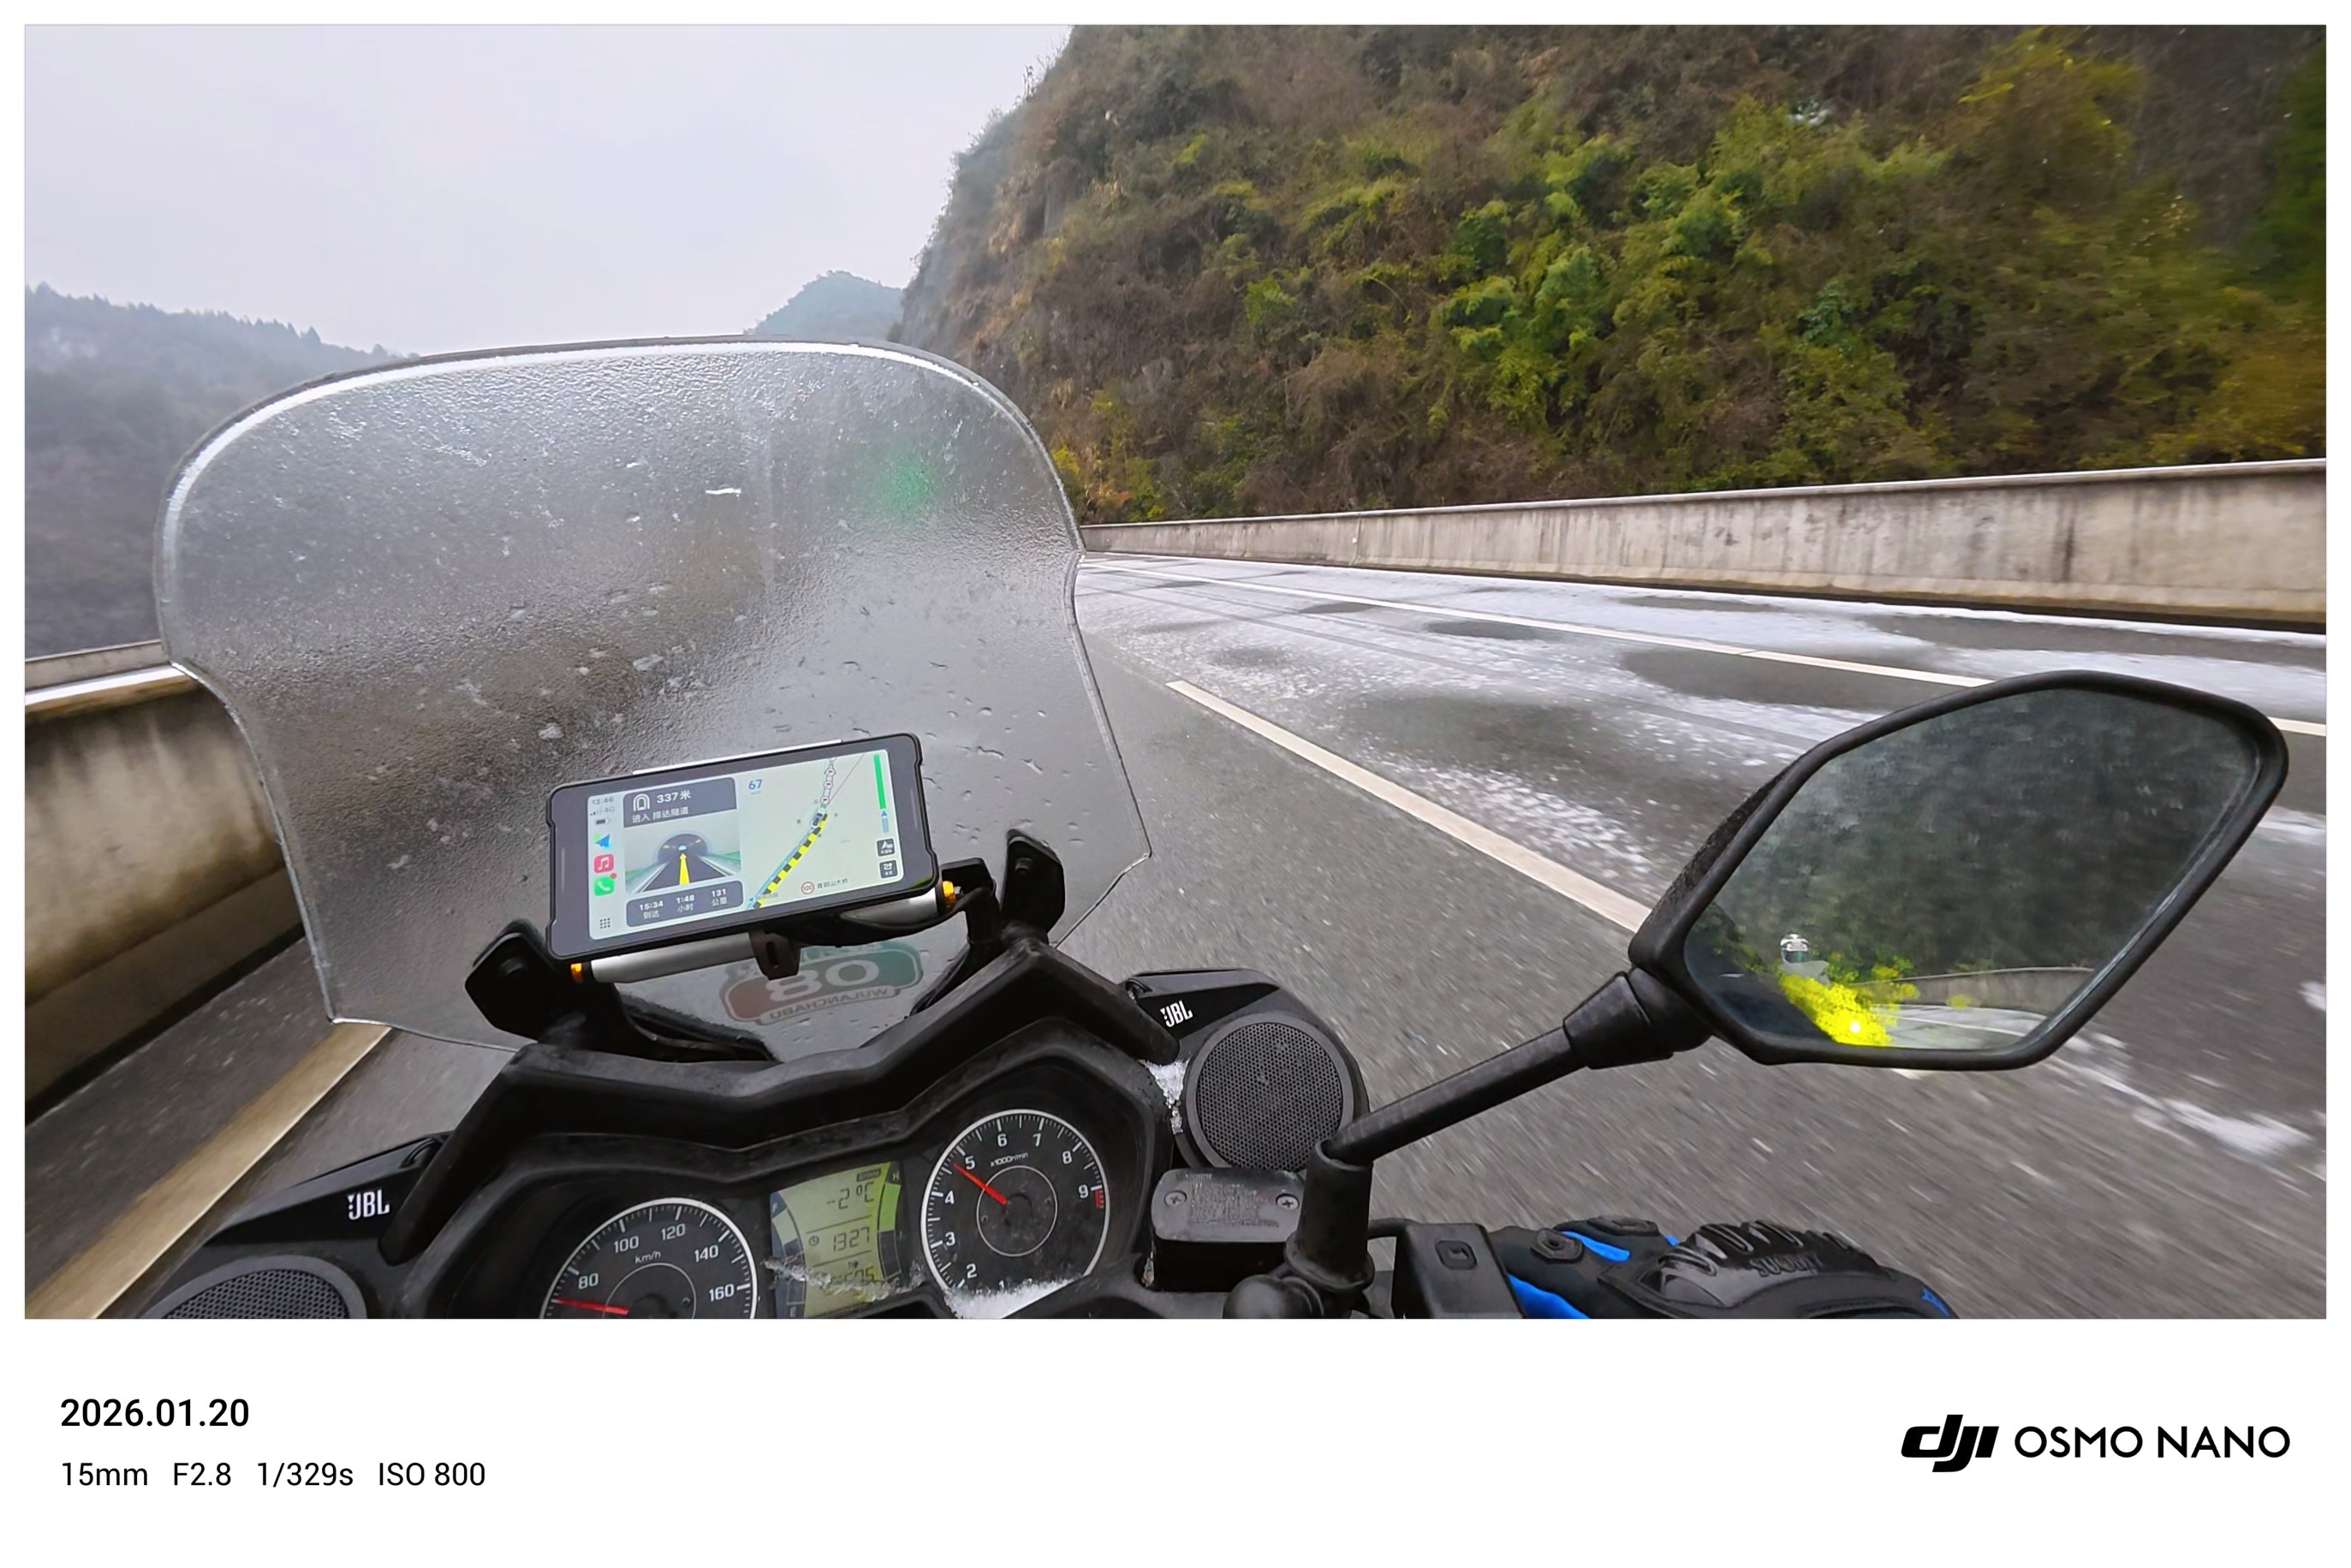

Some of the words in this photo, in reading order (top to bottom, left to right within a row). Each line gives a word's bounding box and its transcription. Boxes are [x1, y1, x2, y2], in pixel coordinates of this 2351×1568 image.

[748, 779, 763, 790] 67
[632, 814, 651, 823] 进入
[676, 894, 695, 904] 1:48
[711, 888, 727, 897] 131
[640, 900, 664, 911] 15:34
[677, 903, 693, 913] 小时
[711, 896, 727, 906] 公里
[643, 910, 660, 919] 到达
[1160, 1000, 1193, 1028] JBL
[997, 1133, 1008, 1147] 6
[1033, 1133, 1042, 1147] 7
[965, 1155, 976, 1170] 5
[1062, 1150, 1073, 1164] 8
[944, 1191, 955, 1205] 4
[1078, 1185, 1089, 1198] 9
[348, 1189, 390, 1221] JBL
[661, 1223, 686, 1241] 120
[945, 1232, 956, 1246] 3
[614, 1236, 640, 1253] 100
[635, 1250, 662, 1264] km/h
[694, 1244, 719, 1262] 140
[966, 1263, 978, 1279] 2
[578, 1273, 599, 1289] 80
[709, 1283, 735, 1302] 160
